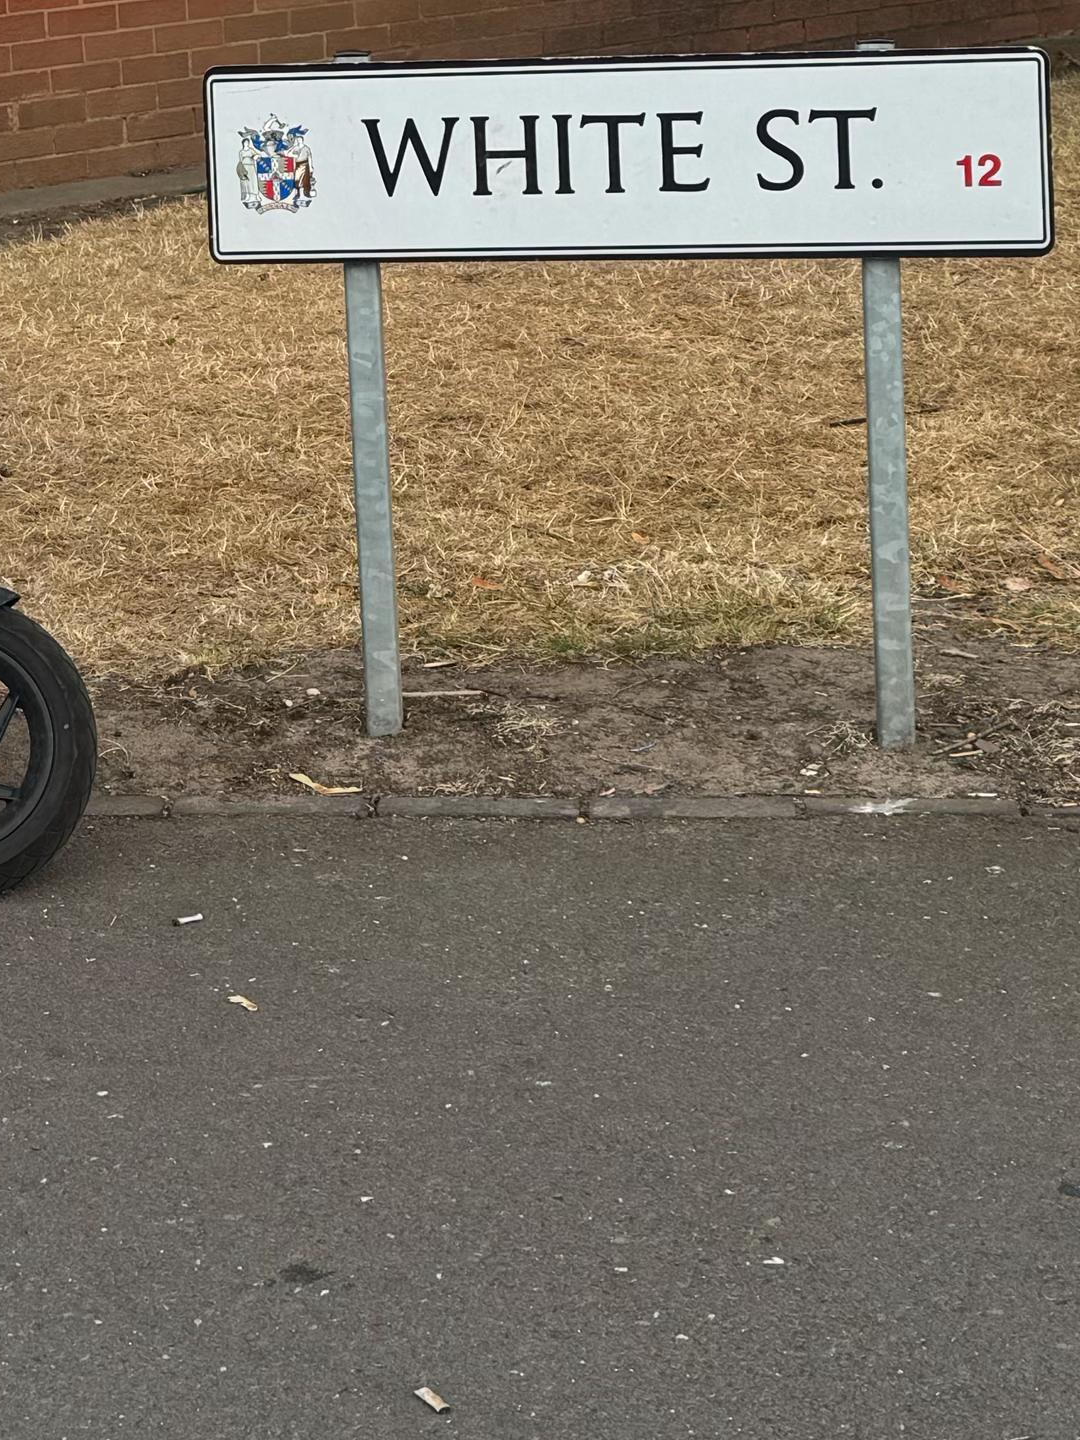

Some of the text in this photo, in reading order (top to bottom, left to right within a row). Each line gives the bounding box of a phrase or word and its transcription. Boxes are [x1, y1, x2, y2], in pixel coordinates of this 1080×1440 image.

[360, 107, 884, 198] WHITE ST.
[955, 154, 1003, 188] 12
